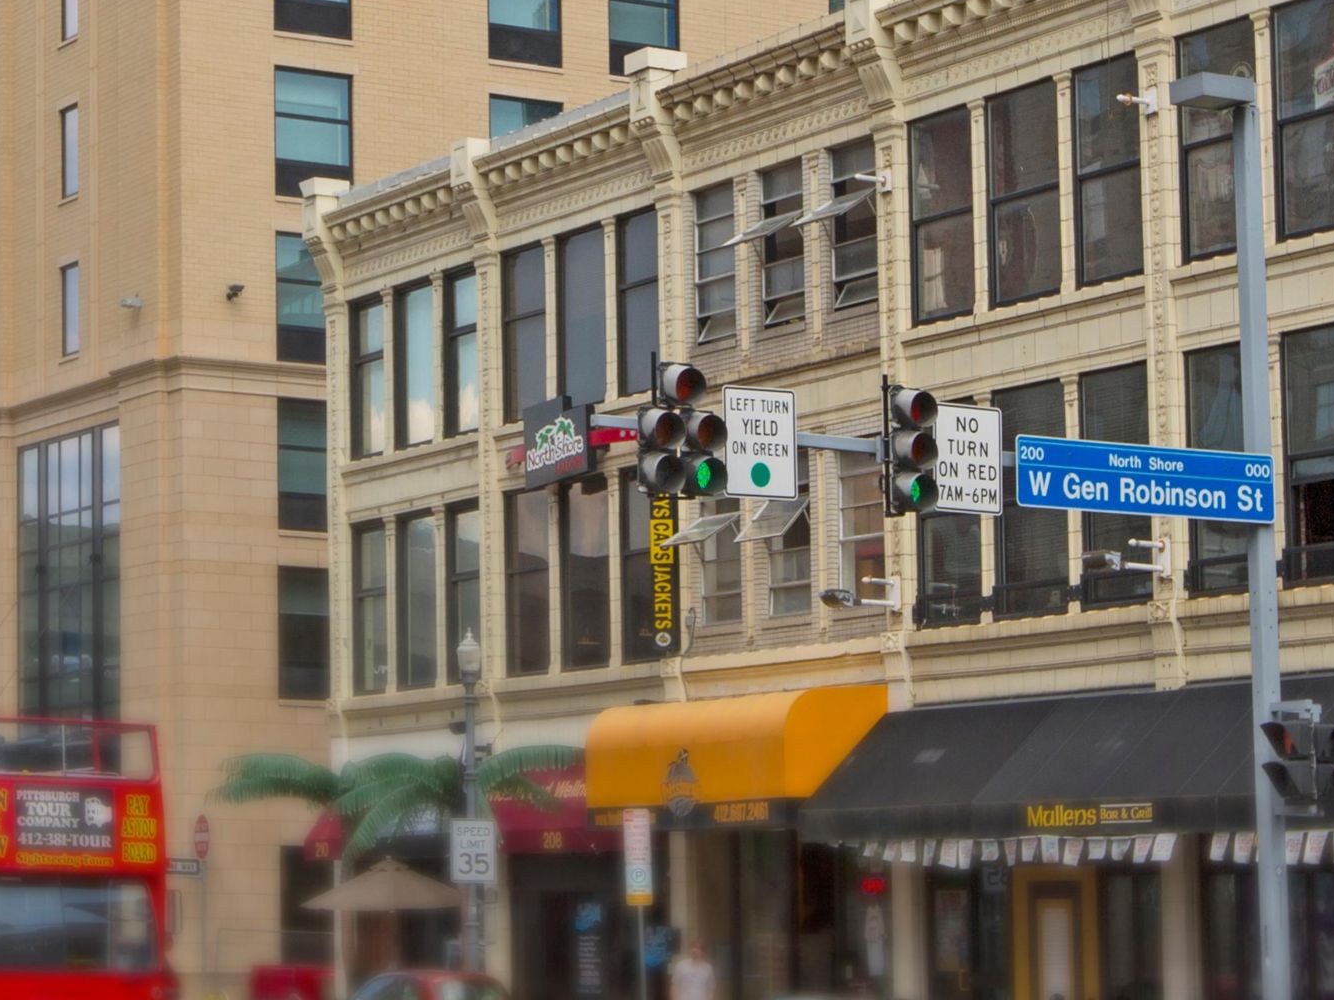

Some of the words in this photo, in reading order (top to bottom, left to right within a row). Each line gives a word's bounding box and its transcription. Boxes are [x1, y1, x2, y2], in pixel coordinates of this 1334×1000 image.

[729, 397, 756, 413] LEFT
[759, 400, 789, 415] TURN
[742, 418, 779, 437] YIELD
[956, 416, 979, 434] NO
[527, 440, 555, 472] North
[554, 433, 585, 463] Shore
[732, 440, 747, 455] ON
[752, 442, 789, 458] GREEN
[947, 438, 989, 459] TURN
[938, 460, 959, 479] ON
[968, 463, 998, 482] RED
[1020, 446, 1045, 462] 200
[1109, 453, 1142, 470] North
[1148, 456, 1184, 473] Shore
[1244, 463, 1270, 479] 000
[938, 484, 998, 506] 7AM-6PM
[1028, 470, 1052, 498] W
[1062, 472, 1109, 502] Gen
[1119, 477, 1227, 510] Robinson
[1237, 485, 1264, 513] St
[652, 522, 671, 562] CAPS
[653, 565, 672, 630] JACKETS
[16, 789, 81, 803] PITTSBURGH
[126, 794, 150, 816] PAY
[24, 802, 72, 817] TOUR
[1027, 804, 1097, 828] Mullens
[1100, 808, 1119, 820] Bar
[1121, 807, 1129, 819] &
[1130, 806, 1153, 819] Grill
[17, 815, 81, 829] COMPANY
[456, 825, 491, 837] SPEED
[17, 831, 113, 849] 412-381-TOUR
[460, 839, 486, 850] LIMIT
[543, 831, 562, 849] 208
[17, 853, 81, 867] Sightseeing
[82, 855, 114, 867] Tours
[122, 842, 157, 863] BOARD
[458, 851, 490, 876] 35
